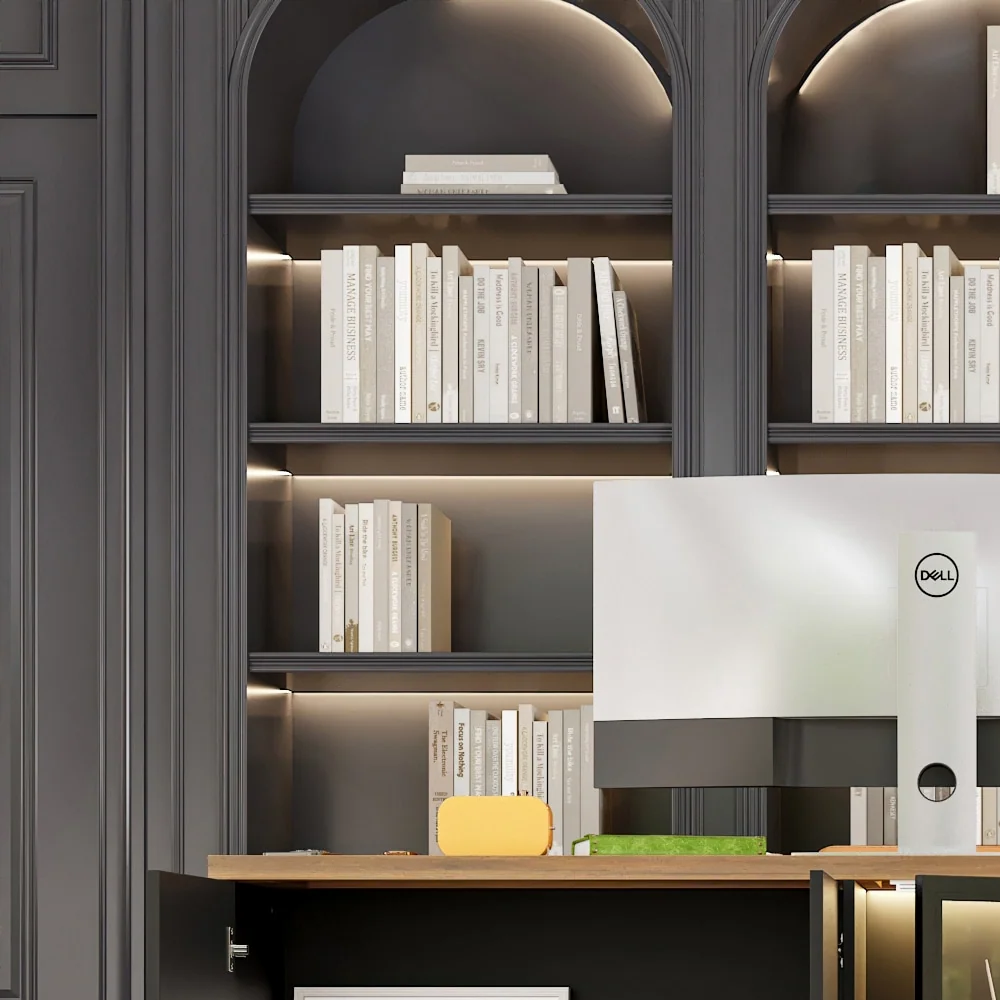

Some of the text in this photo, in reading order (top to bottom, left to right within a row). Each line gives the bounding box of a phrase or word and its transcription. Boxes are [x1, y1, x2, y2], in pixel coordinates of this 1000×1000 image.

[919, 270, 930, 279] To
[919, 280, 930, 295] Kill
[346, 273, 356, 314] MANAGE
[364, 283, 373, 303] YOUR
[429, 271, 440, 347] To Kill Mockingbird
[477, 278, 485, 314] DO THE JOB
[855, 283, 864, 303] YOUR
[968, 277, 977, 314] DO THE JOB
[495, 310, 504, 327] Good
[837, 272, 847, 361] MANAGE BUSINESS
[919, 301, 930, 347] Mockingbird
[986, 311, 995, 327] Good
[346, 316, 356, 361] BUSINESS
[477, 339, 485, 373] KEVIN SRY
[968, 339, 977, 374] KEVIN SRY
[399, 366, 408, 411] author name
[890, 366, 900, 411] author name
[391, 514, 399, 539] ANTHONY
[334, 525, 342, 589] To Kill Mockingbird
[920, 570, 955, 581] DELL
[432, 729, 440, 764] Swagman.
[456, 722, 465, 778] Focus on Nothing
[536, 733, 545, 742] To
[536, 743, 545, 756] Kill
[536, 762, 545, 798] Mockingbi
